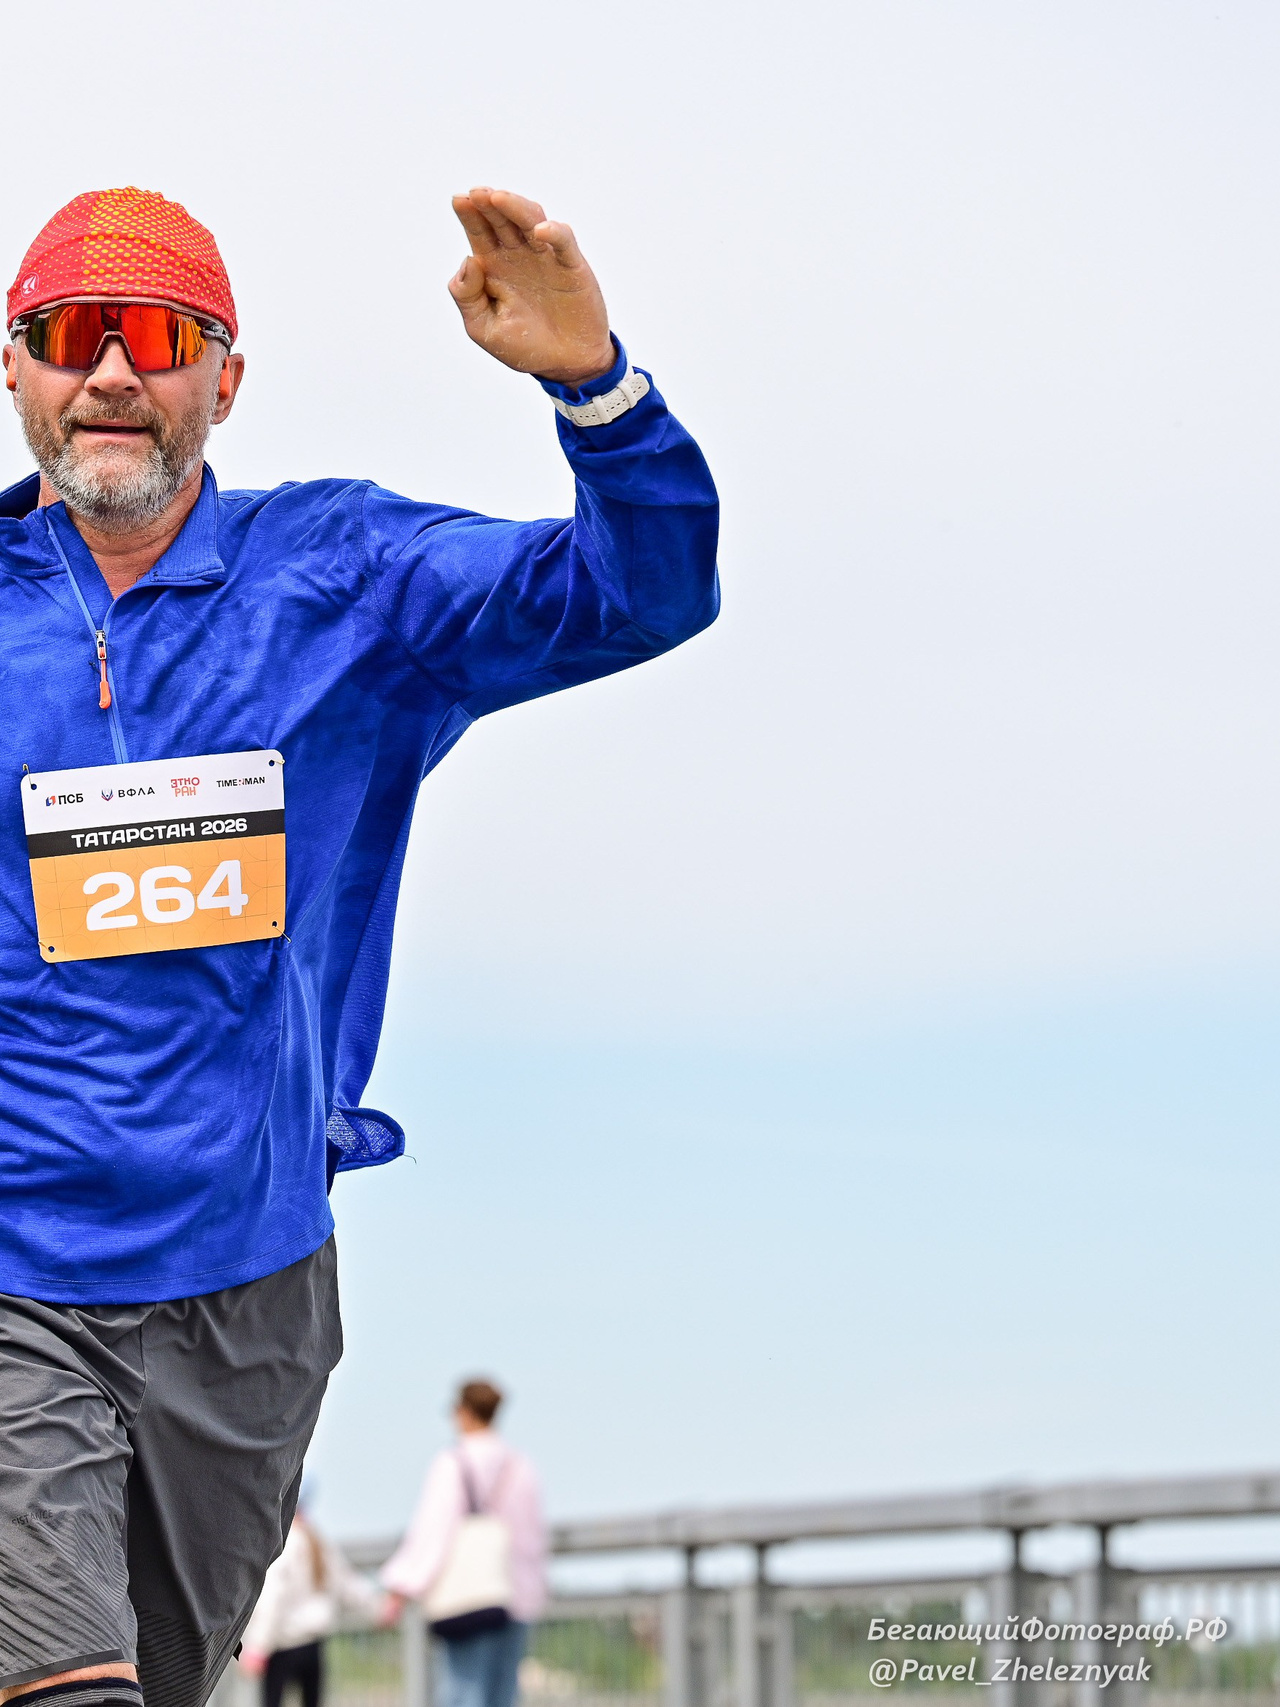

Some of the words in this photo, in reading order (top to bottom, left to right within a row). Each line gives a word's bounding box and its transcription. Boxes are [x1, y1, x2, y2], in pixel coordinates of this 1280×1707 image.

[117, 786, 156, 798] ВФЛА
[174, 785, 197, 797] РАН
[57, 793, 84, 805] ПСБ
[71, 822, 196, 848] ТАТАРСТАН
[200, 817, 248, 836] 2026
[82, 859, 249, 931] 264
